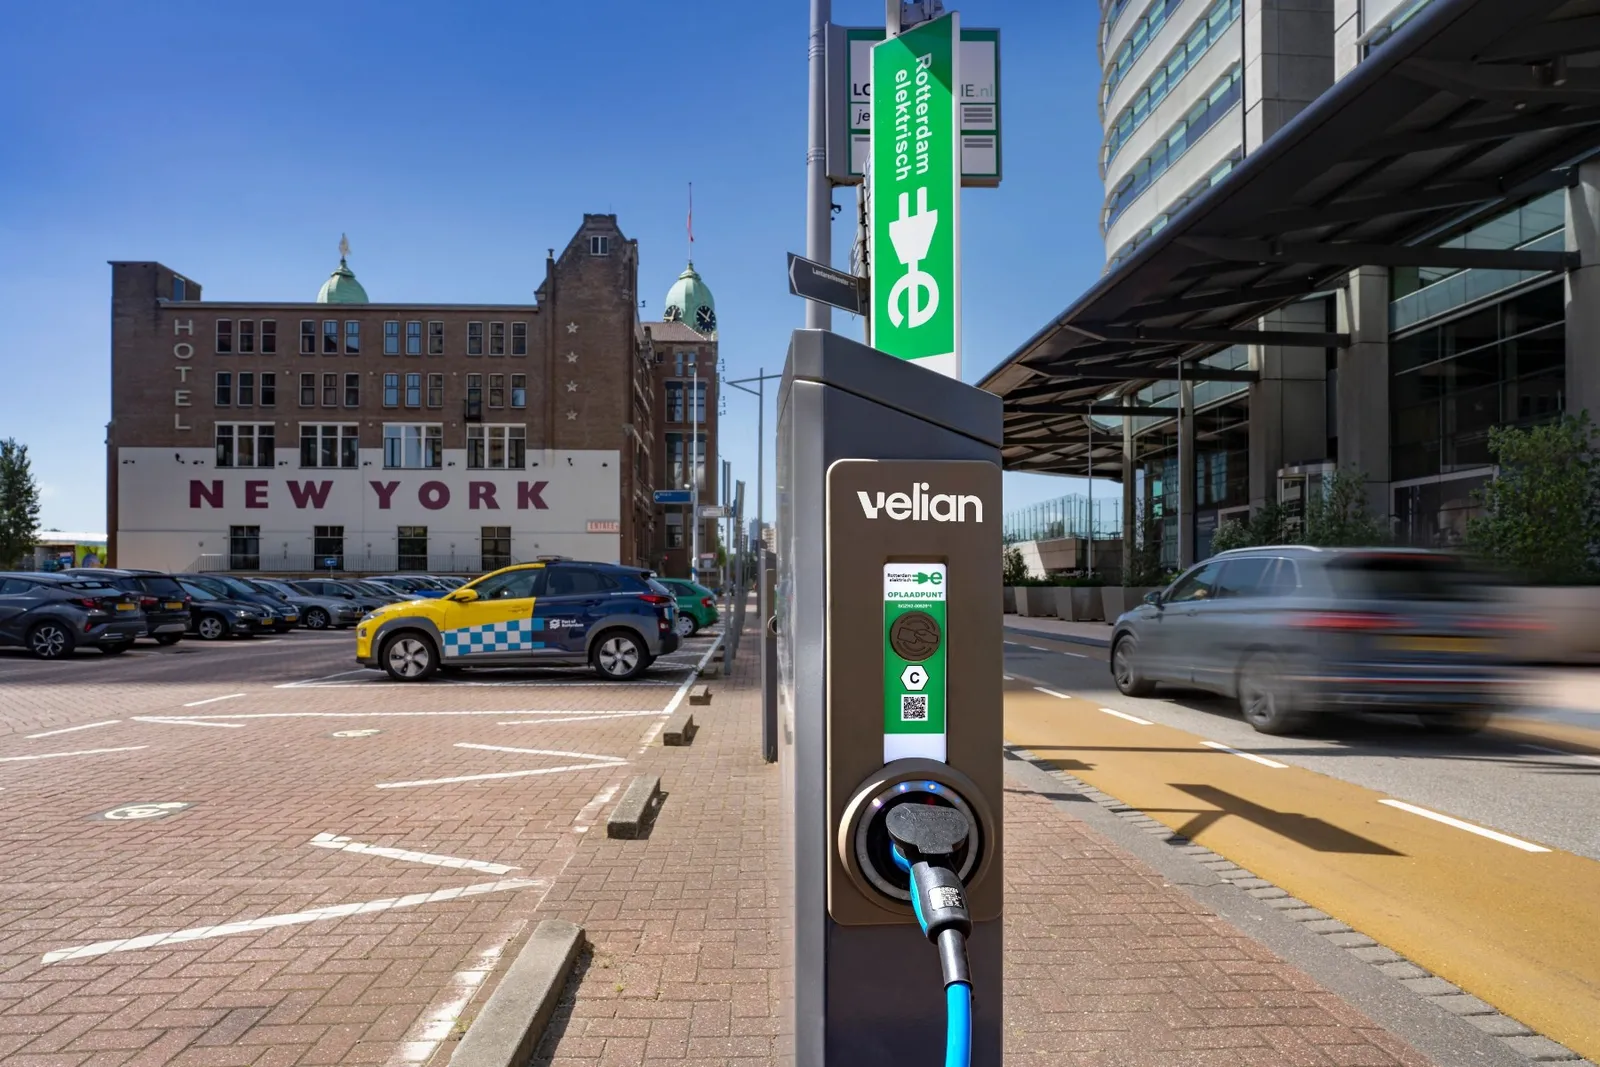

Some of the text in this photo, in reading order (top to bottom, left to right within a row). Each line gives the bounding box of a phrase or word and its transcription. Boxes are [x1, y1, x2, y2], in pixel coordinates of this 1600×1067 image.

[895, 69, 912, 181] elektrisch
[915, 53, 933, 175] Rotterdam
[173, 319, 194, 430] HOTEL
[189, 480, 551, 510] NEW YORK
[856, 482, 983, 523] velian
[910, 671, 920, 684] C
